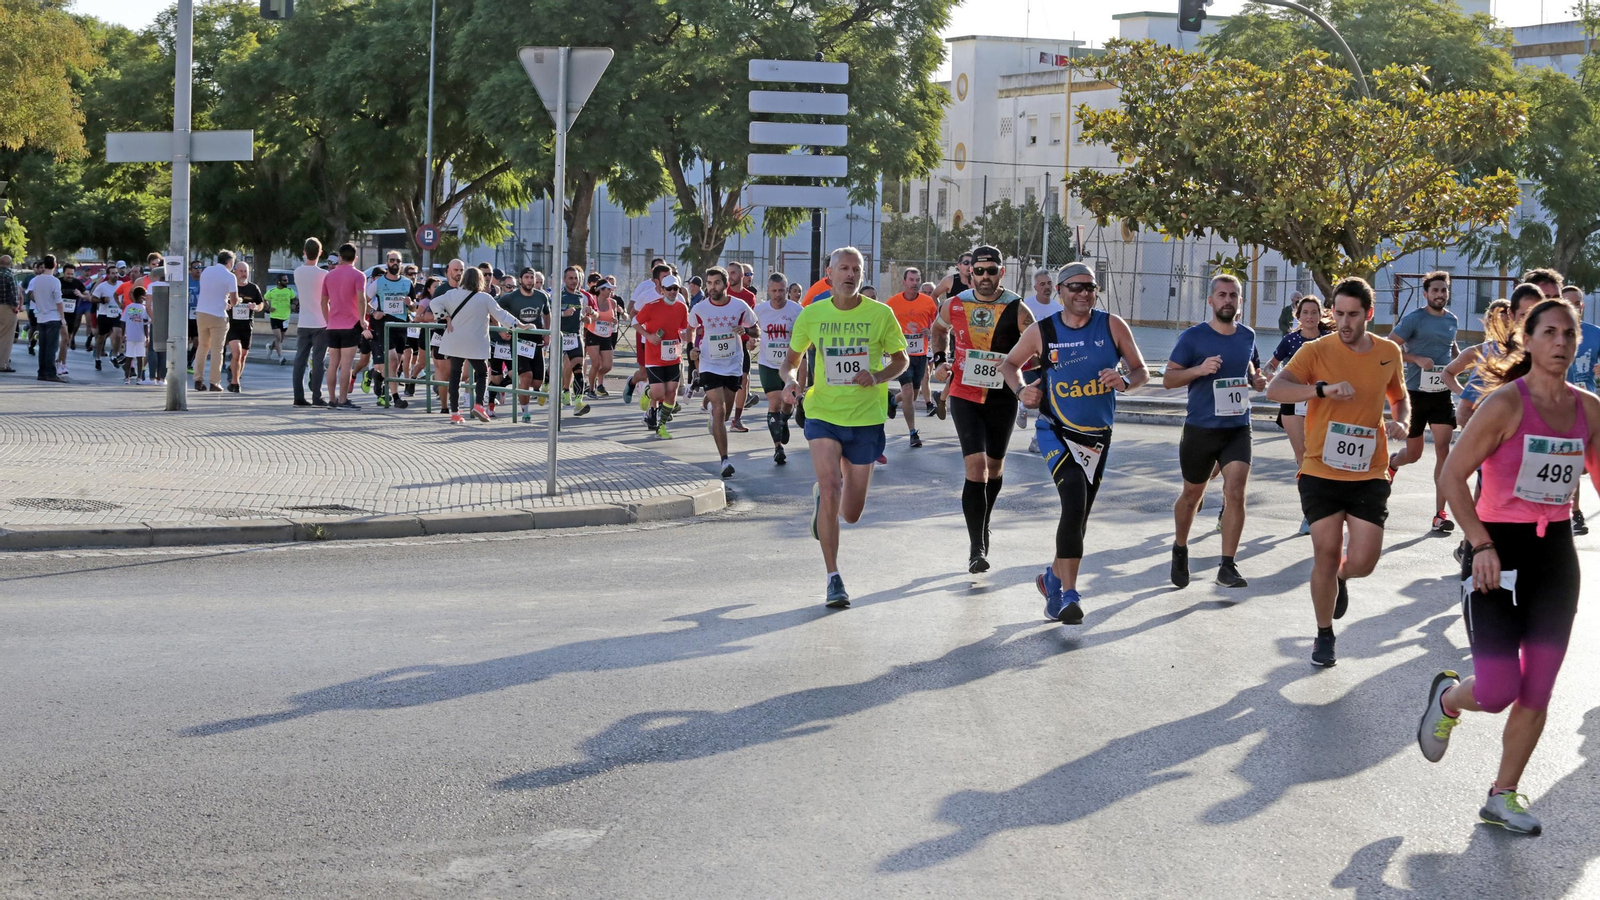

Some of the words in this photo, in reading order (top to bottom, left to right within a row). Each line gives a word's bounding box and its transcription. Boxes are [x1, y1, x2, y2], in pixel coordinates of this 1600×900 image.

[767, 324, 787, 340] RUN
[820, 322, 841, 333] RUN
[844, 322, 871, 335] FAST
[718, 342, 728, 350] 99
[836, 361, 860, 374] 108
[974, 364, 996, 376] 888
[1229, 392, 1241, 403] 10
[1336, 440, 1364, 458] 801
[1536, 463, 1573, 484] 498
